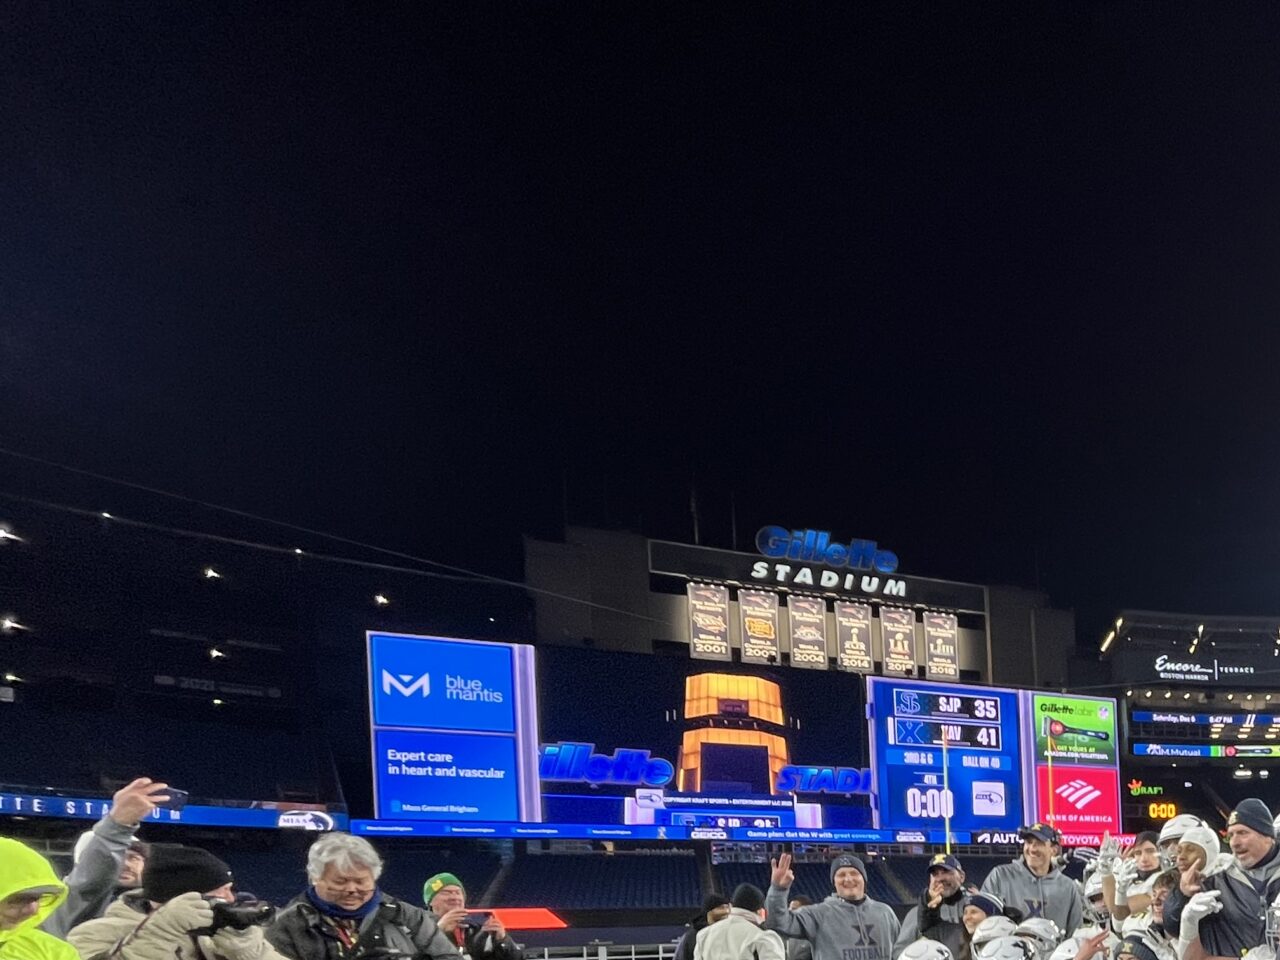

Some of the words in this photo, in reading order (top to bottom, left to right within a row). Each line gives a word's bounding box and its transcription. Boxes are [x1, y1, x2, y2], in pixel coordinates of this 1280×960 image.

[755, 525, 899, 573] Gillette
[751, 561, 906, 597] STADIUM
[696, 644, 726, 653] 2001
[794, 653, 824, 662] 2004
[843, 658, 869, 667] 2014
[1155, 655, 1213, 672] Encore
[931, 666, 954, 674] 2018
[1160, 672, 1184, 680] BOSTON
[1220, 666, 1254, 674] TERRACE
[446, 674, 482, 690] blue
[446, 688, 503, 703] mantis
[939, 697, 961, 712] SJP
[974, 700, 996, 718] 35
[1040, 703, 1074, 715] Gillette
[940, 725, 961, 740] XAV
[976, 728, 997, 746] 41
[387, 749, 426, 762] Expert
[427, 753, 453, 762] care
[904, 752, 919, 764] 3RD
[962, 756, 979, 767] BALL
[980, 757, 990, 768] ON
[388, 763, 399, 774] in
[402, 764, 432, 775] heart
[434, 766, 456, 777] and
[458, 768, 505, 778] vascular
[924, 774, 937, 784] 4TH
[907, 788, 954, 818] 0:00
[67, 801, 181, 820] STAUM
[1149, 803, 1176, 818] 0:00
[691, 831, 727, 840] GEICO
[768, 831, 784, 839] plan:
[1063, 835, 1100, 844] TOYOTA
[842, 948, 889, 960] FOOTBALL
